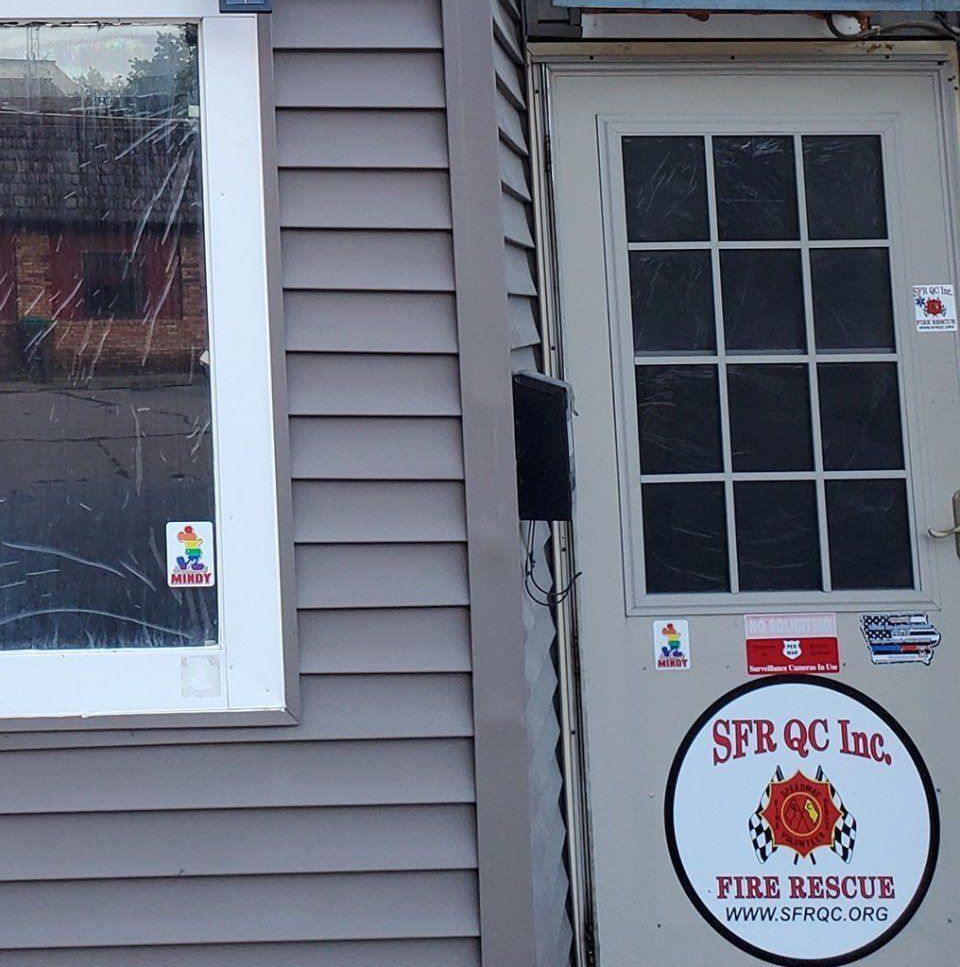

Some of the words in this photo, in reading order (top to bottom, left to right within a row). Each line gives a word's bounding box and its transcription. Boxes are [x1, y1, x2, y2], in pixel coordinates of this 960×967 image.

[170, 573, 212, 585] MINDY
[749, 618, 765, 633] NO
[712, 718, 777, 766] SFR
[783, 718, 830, 758] QC
[837, 719, 892, 766] Inc.
[716, 876, 781, 899] FIRE
[788, 876, 896, 899] RESCUE
[726, 906, 888, 922] WWW.SFRQC.ORG
